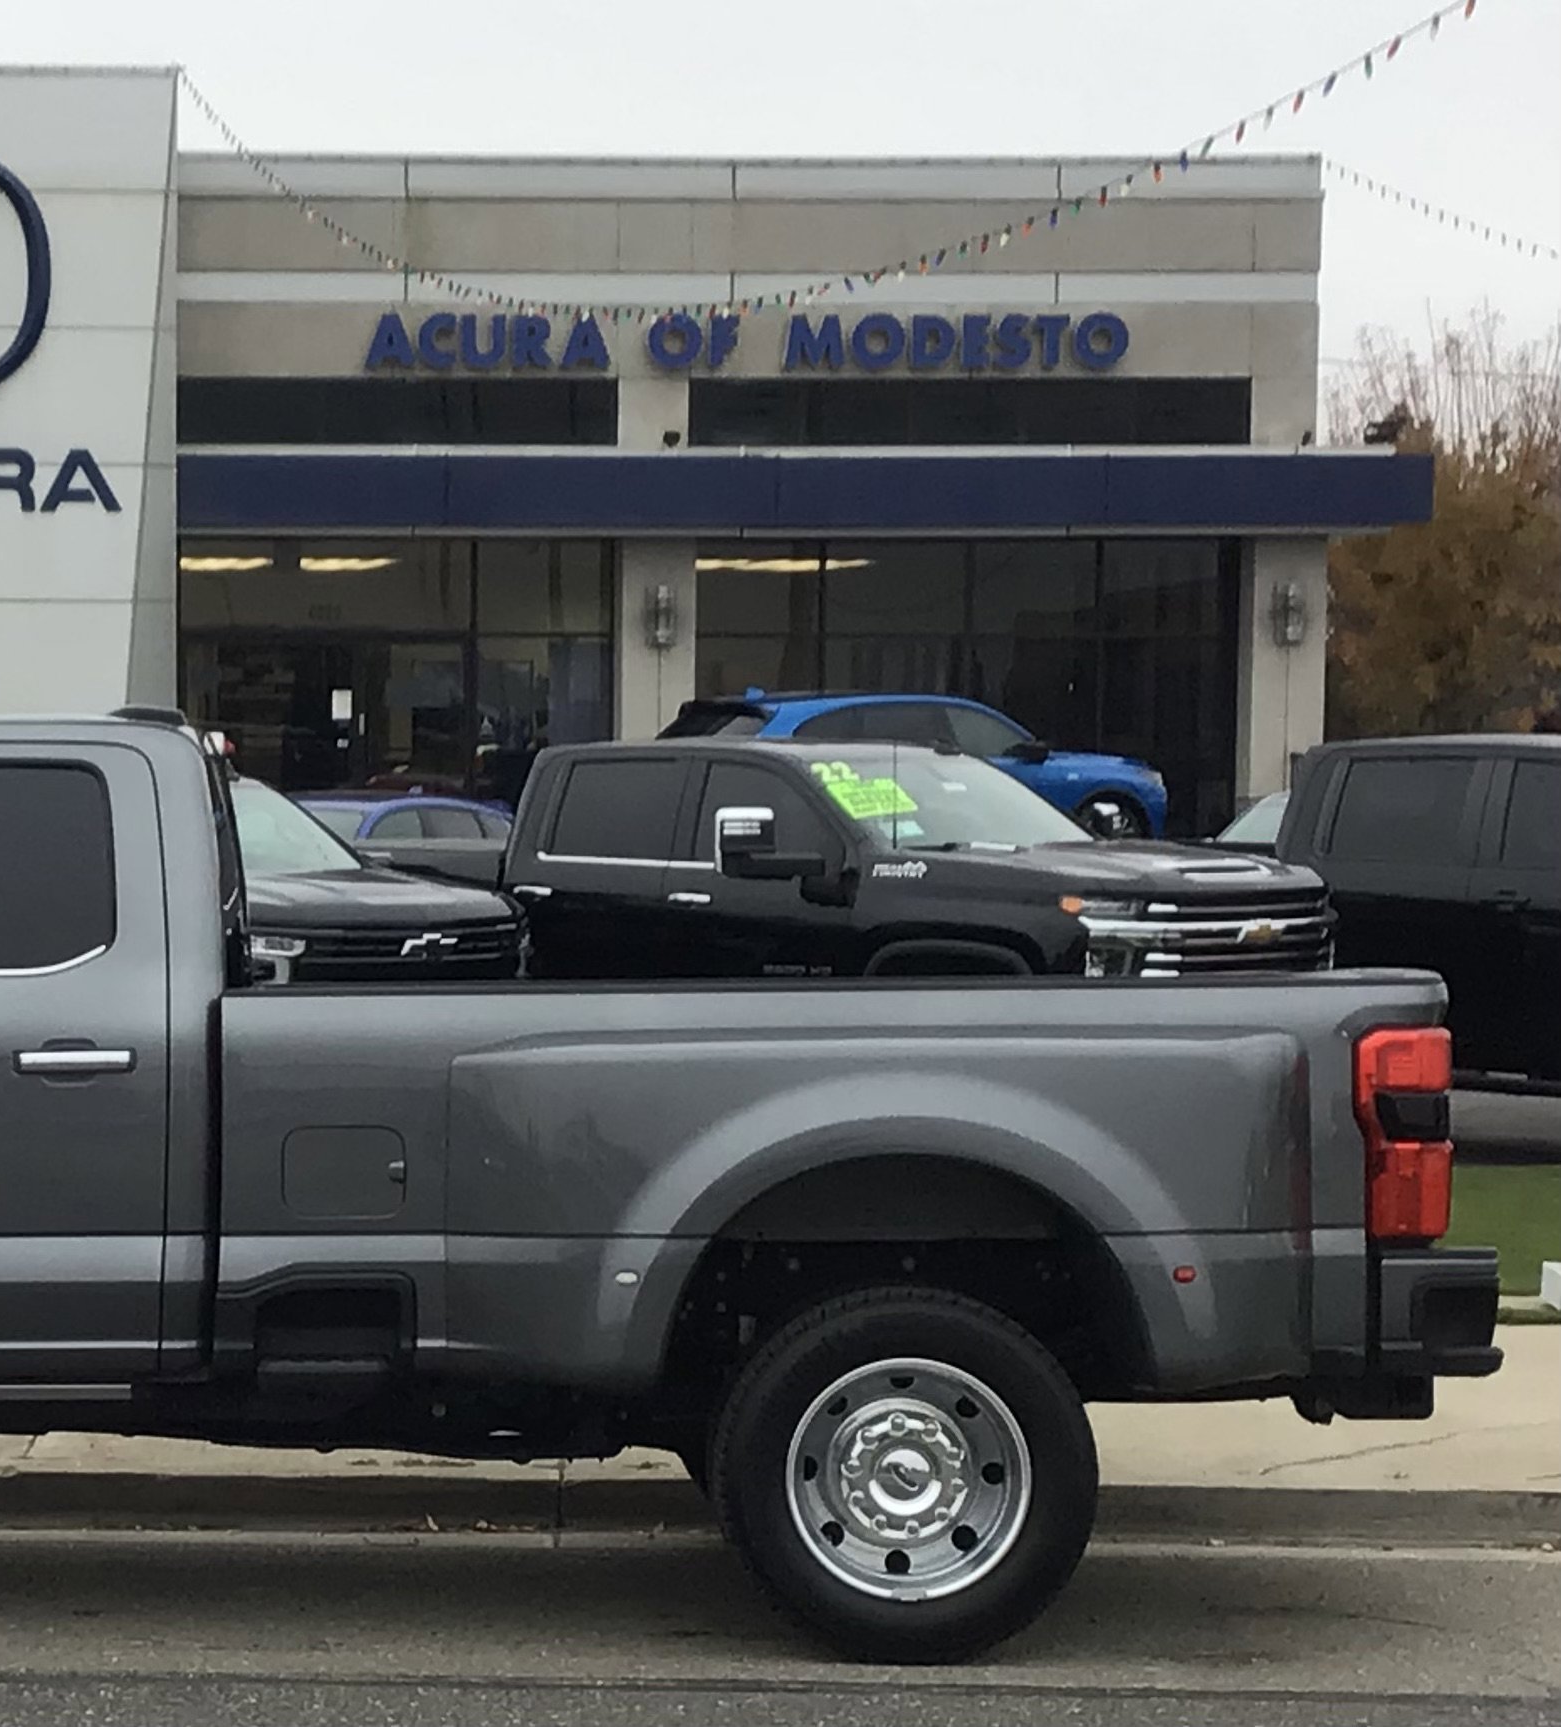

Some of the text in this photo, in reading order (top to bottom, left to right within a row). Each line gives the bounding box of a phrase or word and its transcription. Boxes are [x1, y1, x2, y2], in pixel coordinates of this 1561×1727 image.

[364, 311, 1130, 370] ACURA OF MODESTO
